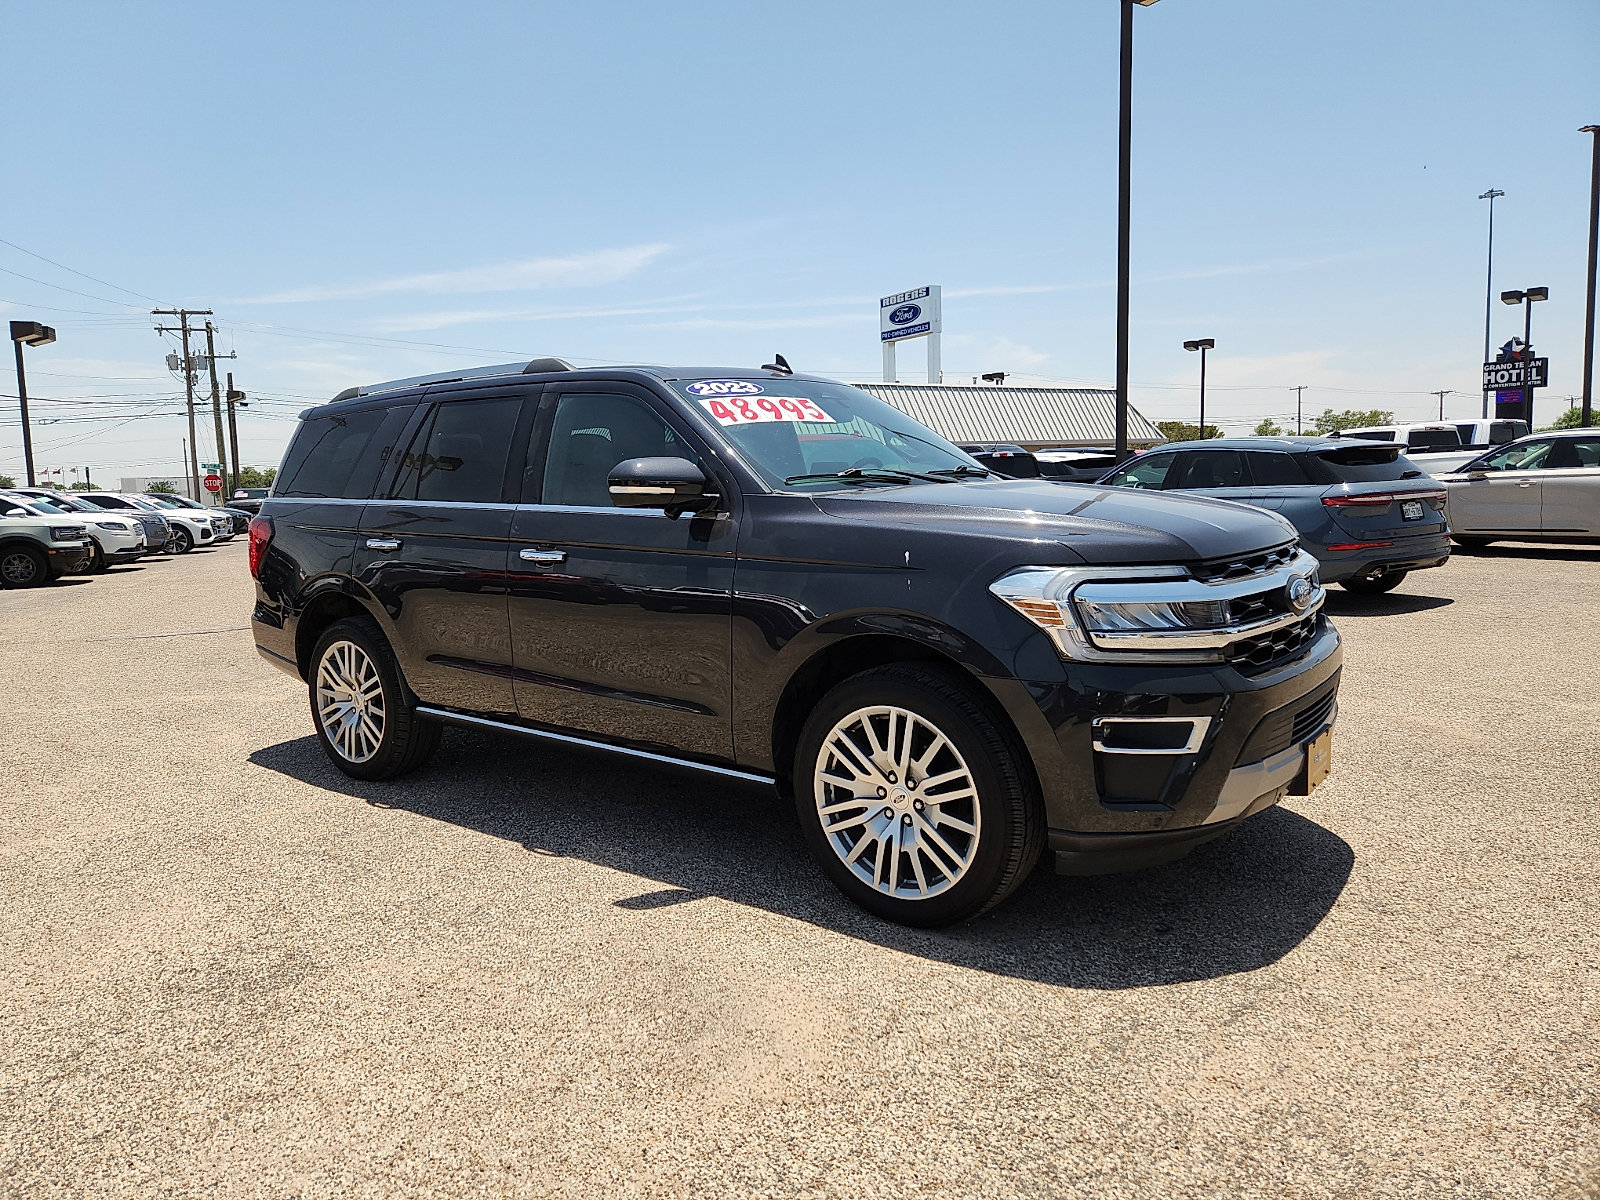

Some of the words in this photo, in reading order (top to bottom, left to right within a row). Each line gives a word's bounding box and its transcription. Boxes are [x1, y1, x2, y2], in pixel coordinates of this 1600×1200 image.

[882, 287, 927, 307] ROGERS
[895, 307, 914, 322] Ford
[908, 323, 929, 334] VEHICLES
[1484, 362, 1513, 371] GRAND
[1514, 360, 1542, 368] TEAN
[694, 381, 758, 396] 2023
[709, 398, 825, 423] 48995
[204, 479, 222, 487] STOP
